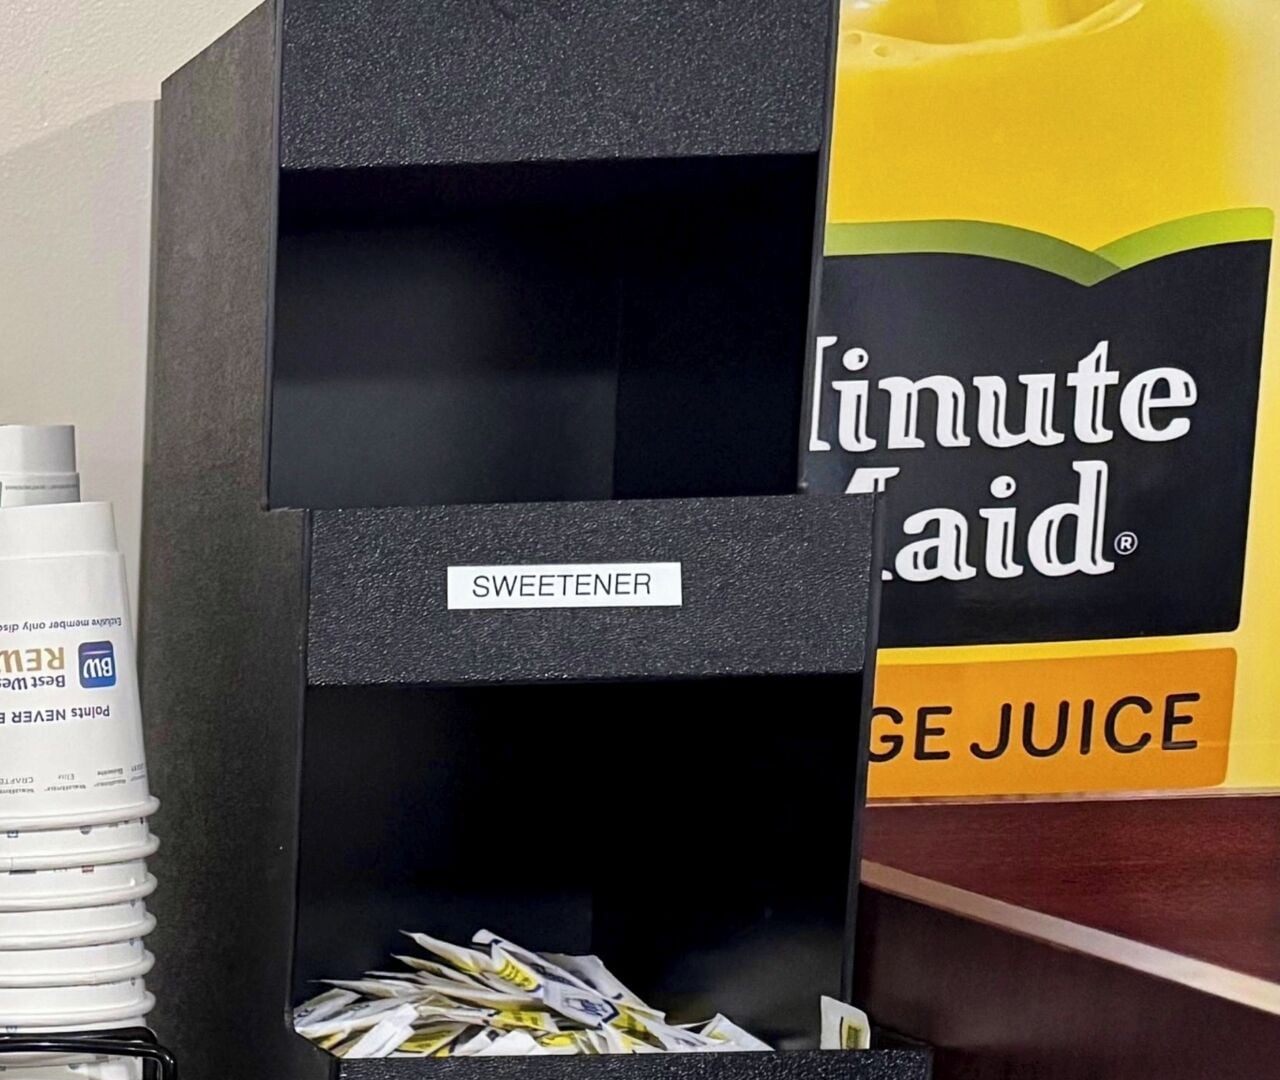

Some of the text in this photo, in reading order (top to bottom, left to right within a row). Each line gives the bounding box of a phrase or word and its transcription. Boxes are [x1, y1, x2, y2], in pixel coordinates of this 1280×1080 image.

[471, 572, 652, 598] SWEETENER
[22, 620, 47, 632] only
[48, 618, 90, 630] member
[82, 656, 114, 679] BW
[31, 674, 66, 689] Best
[11, 708, 66, 724] NEVER
[71, 704, 111, 718] Points
[866, 692, 1201, 763] GE JUICE
